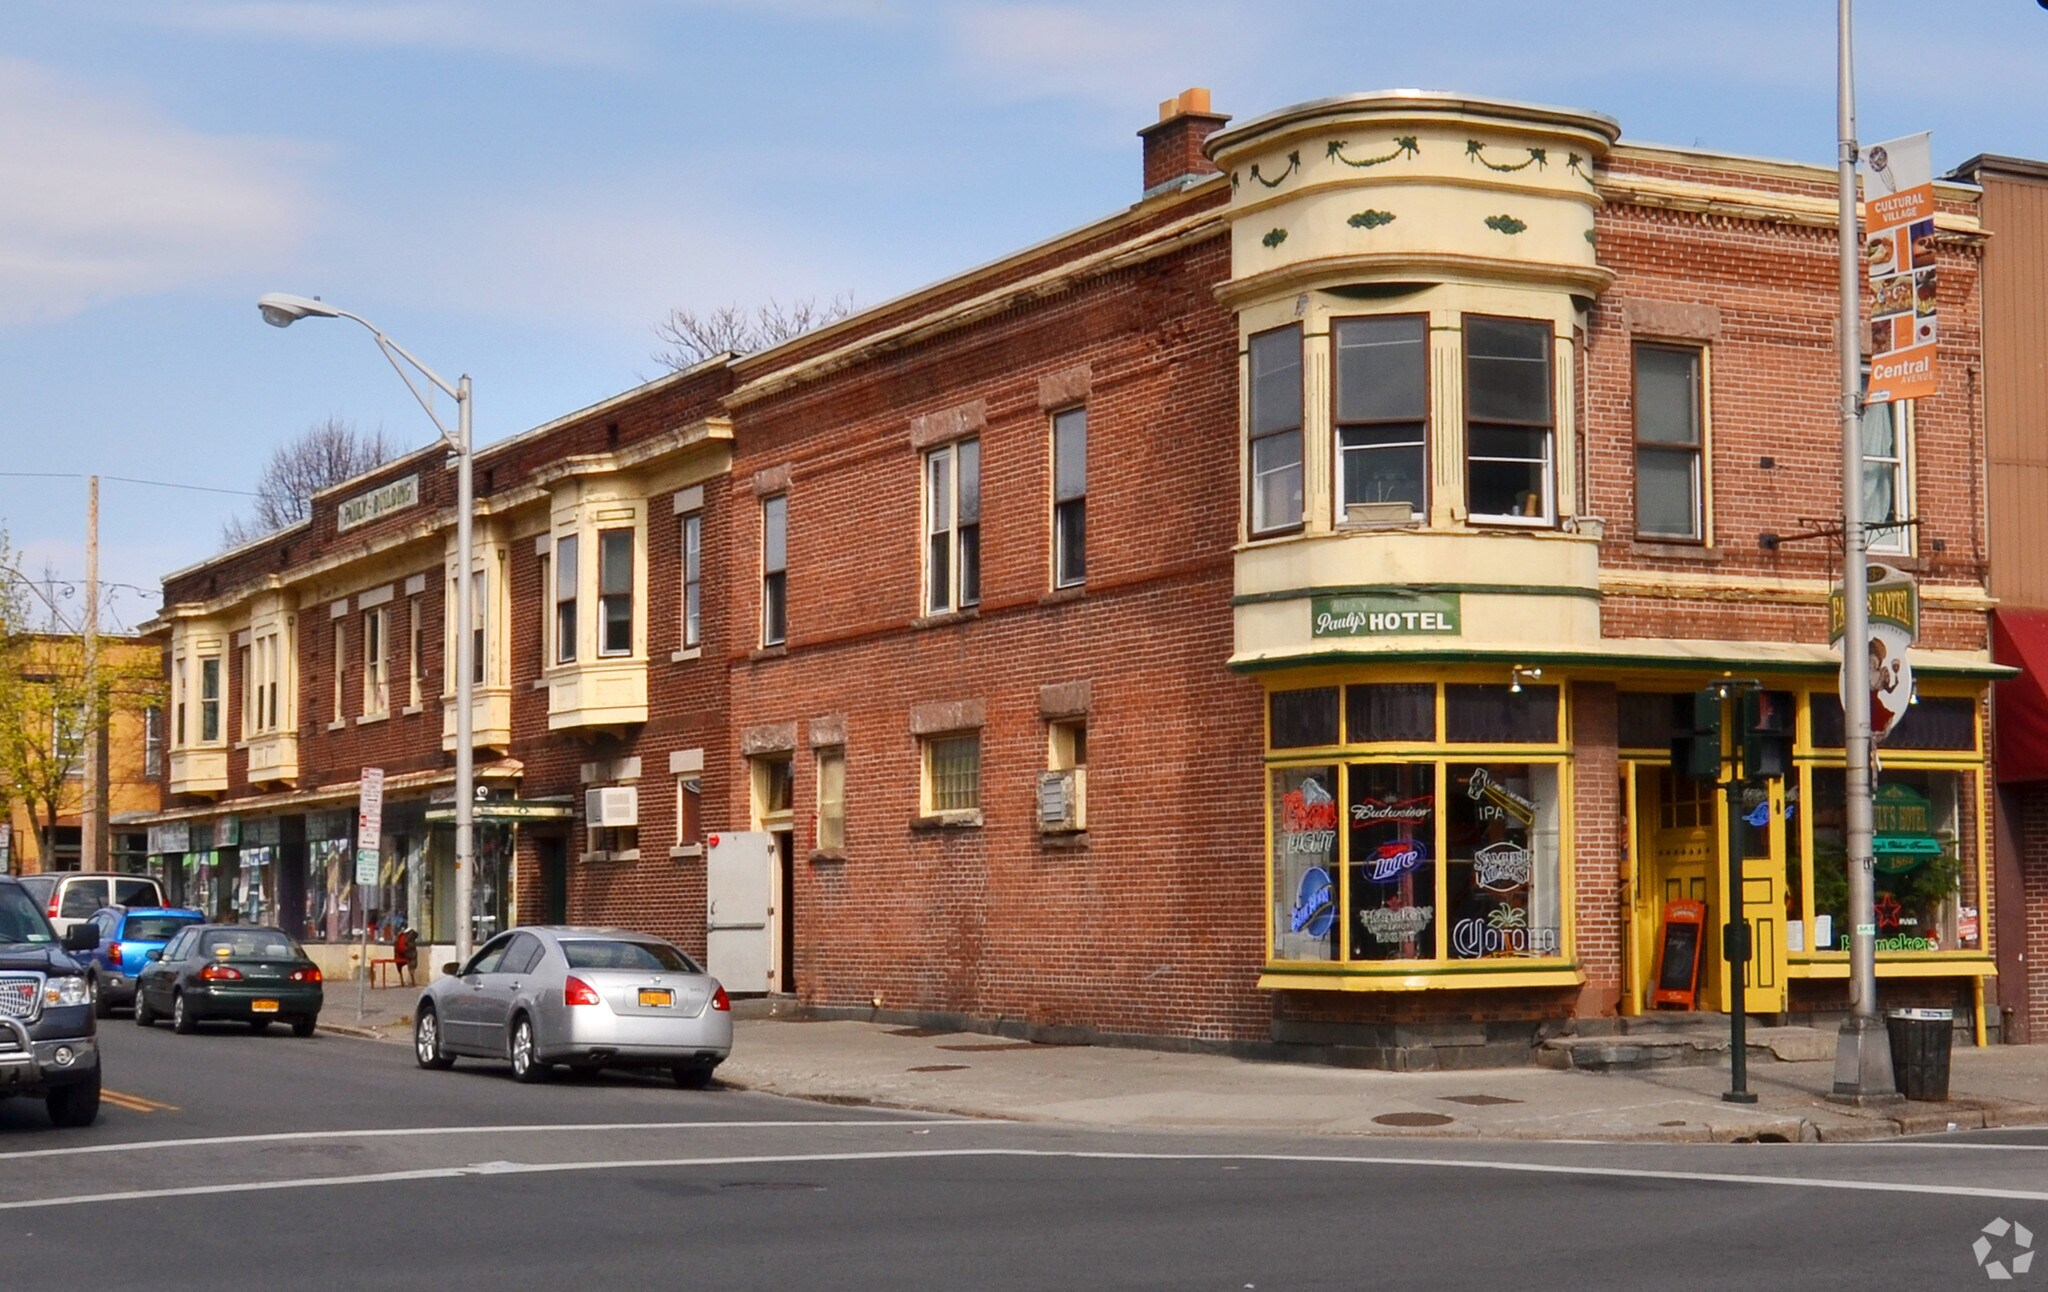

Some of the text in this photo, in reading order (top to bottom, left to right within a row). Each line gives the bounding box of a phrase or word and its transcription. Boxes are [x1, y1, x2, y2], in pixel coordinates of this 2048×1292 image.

[1875, 193, 1925, 214] CULTURAL
[1882, 206, 1917, 223] VILLAGE
[1873, 355, 1929, 380] Central
[1901, 371, 1934, 384] AVENUE
[1875, 589, 1911, 626] HOTEL
[1315, 611, 1453, 634] Pauly's HOTEL
[1350, 804, 1431, 820] Budweiser
[1479, 805, 1505, 820] IPA
[1288, 830, 1336, 854] LIGHT
[1453, 918, 1556, 960] Corona
